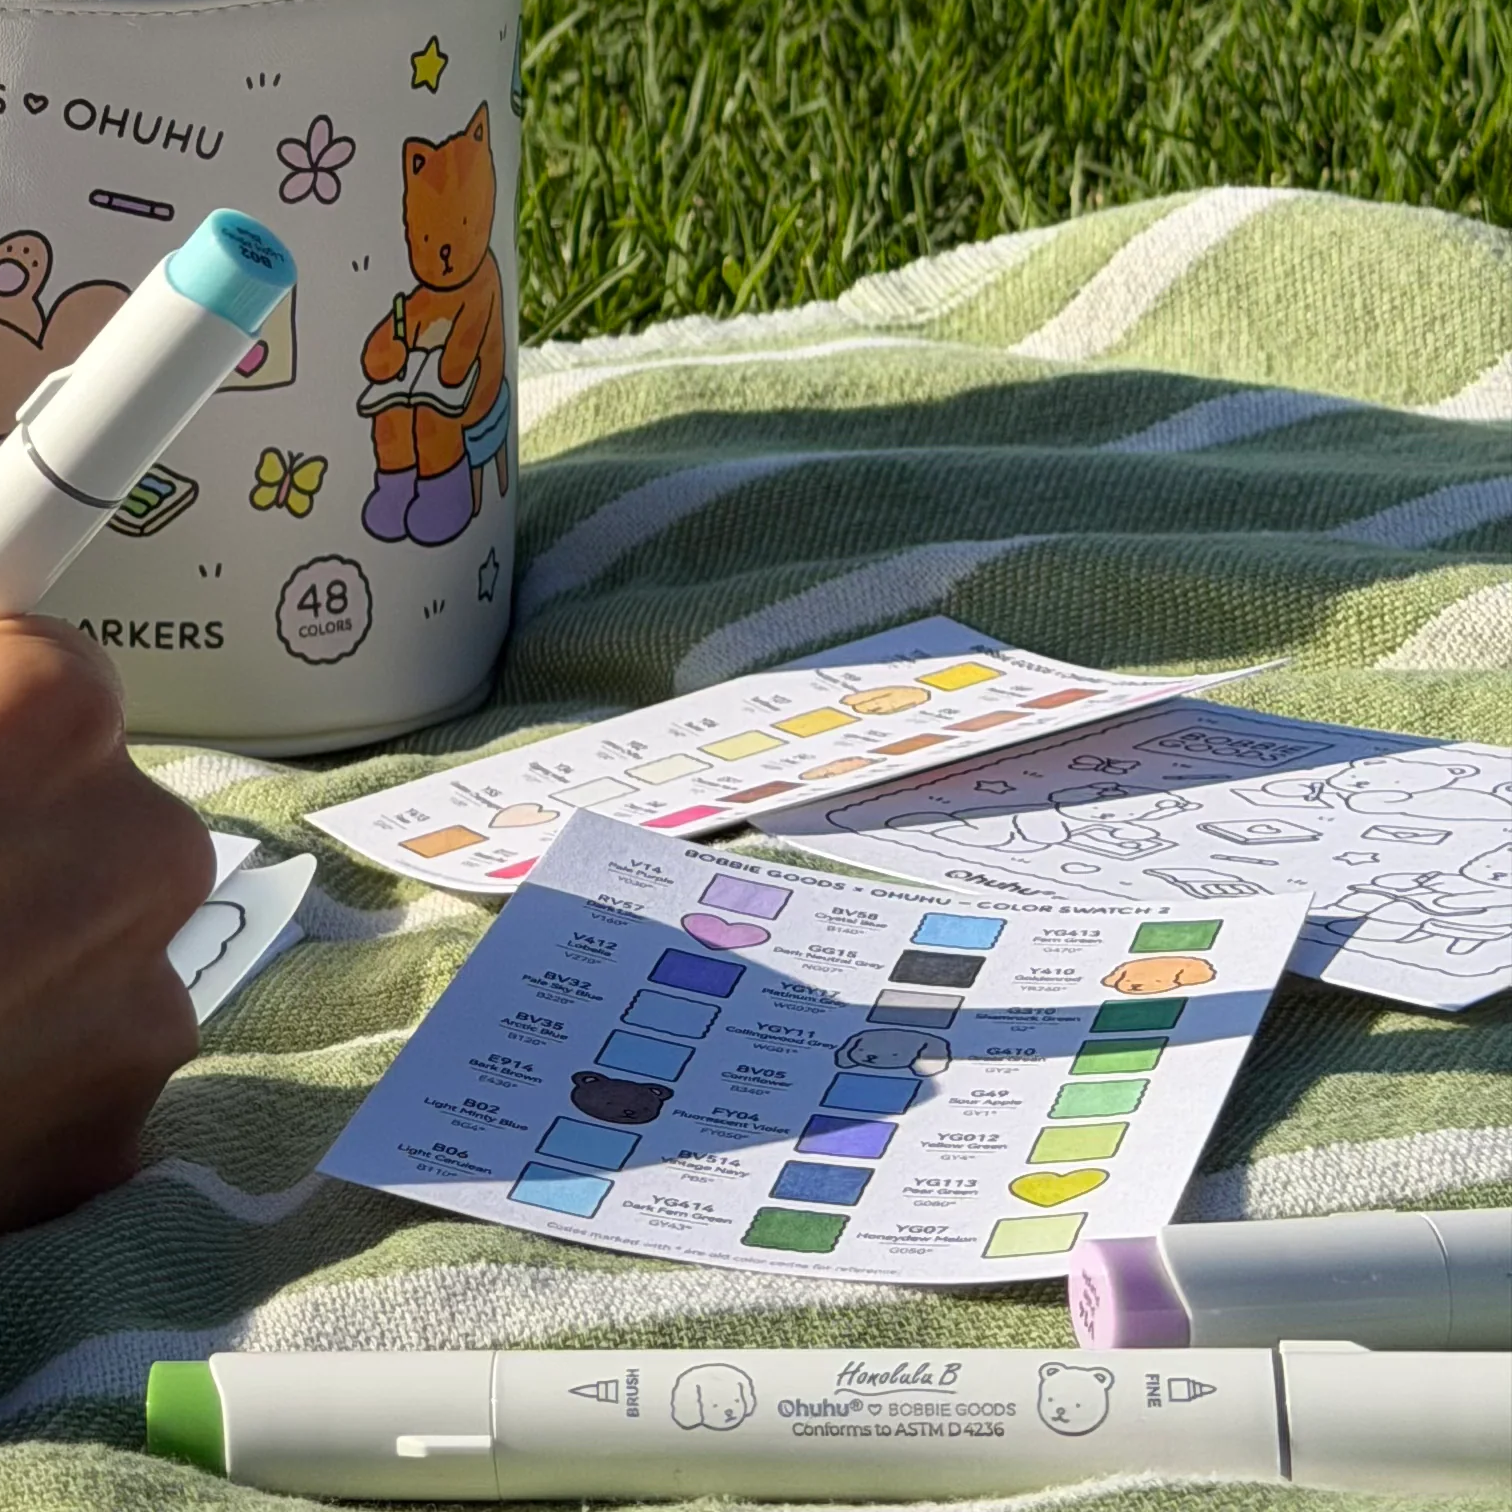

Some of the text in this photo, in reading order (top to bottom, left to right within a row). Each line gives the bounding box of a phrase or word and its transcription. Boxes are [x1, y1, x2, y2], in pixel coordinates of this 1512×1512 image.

[63, 98, 224, 161] OHUHU
[296, 579, 350, 618] 48
[78, 618, 224, 650] ARKERS
[298, 618, 353, 638] COLORS
[1159, 738, 1278, 762] GOODS
[1180, 732, 1309, 756] BOBBIE
[608, 861, 675, 885] Pale Purple
[629, 858, 663, 875] V14
[685, 849, 761, 875] BOBBIE
[767, 869, 846, 891] GOODS
[871, 888, 951, 906] OHUHU
[976, 901, 1053, 913] COLOR
[1058, 905, 1152, 915] SWATCH
[1157, 906, 1171, 915] 2
[598, 893, 645, 911] RV57
[814, 912, 857, 927] Crystal
[831, 906, 879, 921] BV58
[573, 931, 618, 951] V412
[1042, 929, 1101, 937] YG413
[567, 939, 613, 957] Lobelia
[773, 945, 803, 958] Dark
[805, 951, 852, 965] Neutral
[543, 970, 592, 990] BV32
[1030, 967, 1075, 975] Y410
[521, 973, 604, 1002] Pale Sky Blue
[761, 987, 816, 1003] Platinum
[780, 981, 841, 998] YGY17
[500, 1016, 569, 1041] Arctic Blue
[515, 1011, 565, 1031] BV35
[756, 1022, 815, 1039] YGY11
[725, 1023, 805, 1046] Collingwood
[986, 1047, 1036, 1055] G410
[468, 1058, 543, 1084] Bark Brown
[488, 1053, 535, 1073] E914
[736, 1064, 786, 1079] BV05
[721, 1071, 794, 1088] Cornflower
[423, 1096, 529, 1132] Light Minty Blue
[463, 1097, 500, 1115] B02
[711, 1106, 760, 1122] FY04
[672, 1109, 791, 1134] Fluorescent Violet
[937, 1133, 1000, 1142] YG012
[397, 1143, 492, 1176] Light Cerulean
[431, 1142, 470, 1160] B06
[678, 1149, 740, 1168] BV514
[661, 1156, 750, 1178] Vintage Navy
[914, 1178, 977, 1187] YG113
[622, 1200, 732, 1224] Dark Fern Green
[652, 1195, 716, 1213] YG414
[856, 1232, 977, 1243] Honeydew Melon
[896, 1224, 949, 1233] YG07
[836, 1361, 962, 1387] Honolulu B
[626, 1368, 640, 1417] BRUSH
[1145, 1373, 1162, 1408] FINE
[889, 1402, 951, 1417] BOBBIE
[955, 1402, 1017, 1417] GOODS
[792, 1421, 874, 1437] Conforms
[876, 1423, 892, 1437] to
[894, 1422, 944, 1437] ASTM
